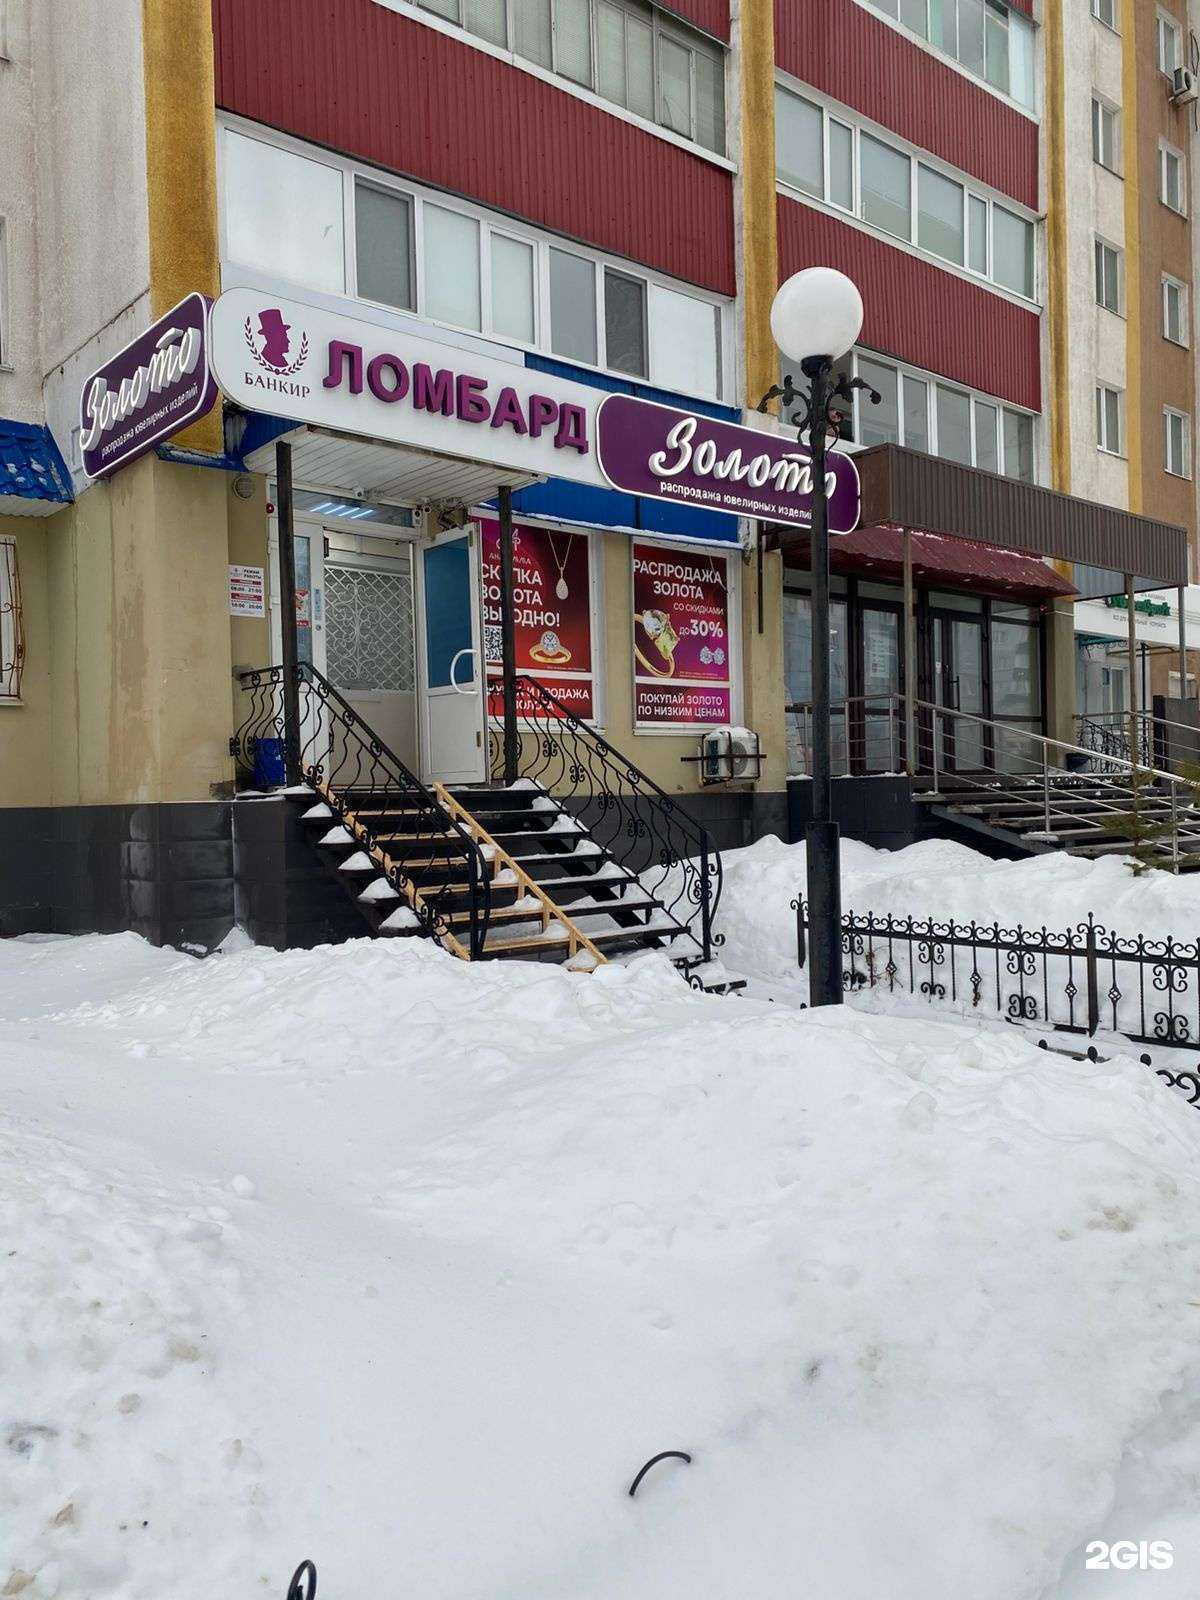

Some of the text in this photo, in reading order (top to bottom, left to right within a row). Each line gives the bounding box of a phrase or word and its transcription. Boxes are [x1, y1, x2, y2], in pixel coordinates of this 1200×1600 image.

[79, 327, 201, 451] Золото
[243, 371, 311, 399] БАНКИР
[135, 404, 170, 434] ювелирных
[169, 382, 199, 412] изделий
[322, 339, 590, 455] ЛОМБАРД
[660, 480, 721, 502] распродажа
[723, 493, 776, 514] ювелирных
[481, 563, 543, 586] СКПКА
[632, 558, 722, 584] РАСПРОДАЖА
[481, 584, 543, 606] ЗООТА
[653, 580, 704, 600] ЗОЛОТА
[482, 604, 560, 628] ВЫОДНО!
[673, 602, 685, 611] СО
[690, 618, 724, 639] 30%
[640, 693, 723, 706] ПОКУПАЙ ЗОЛОТО
[638, 705, 725, 718] ПО НИЗКИМ ЦЕНАМ
